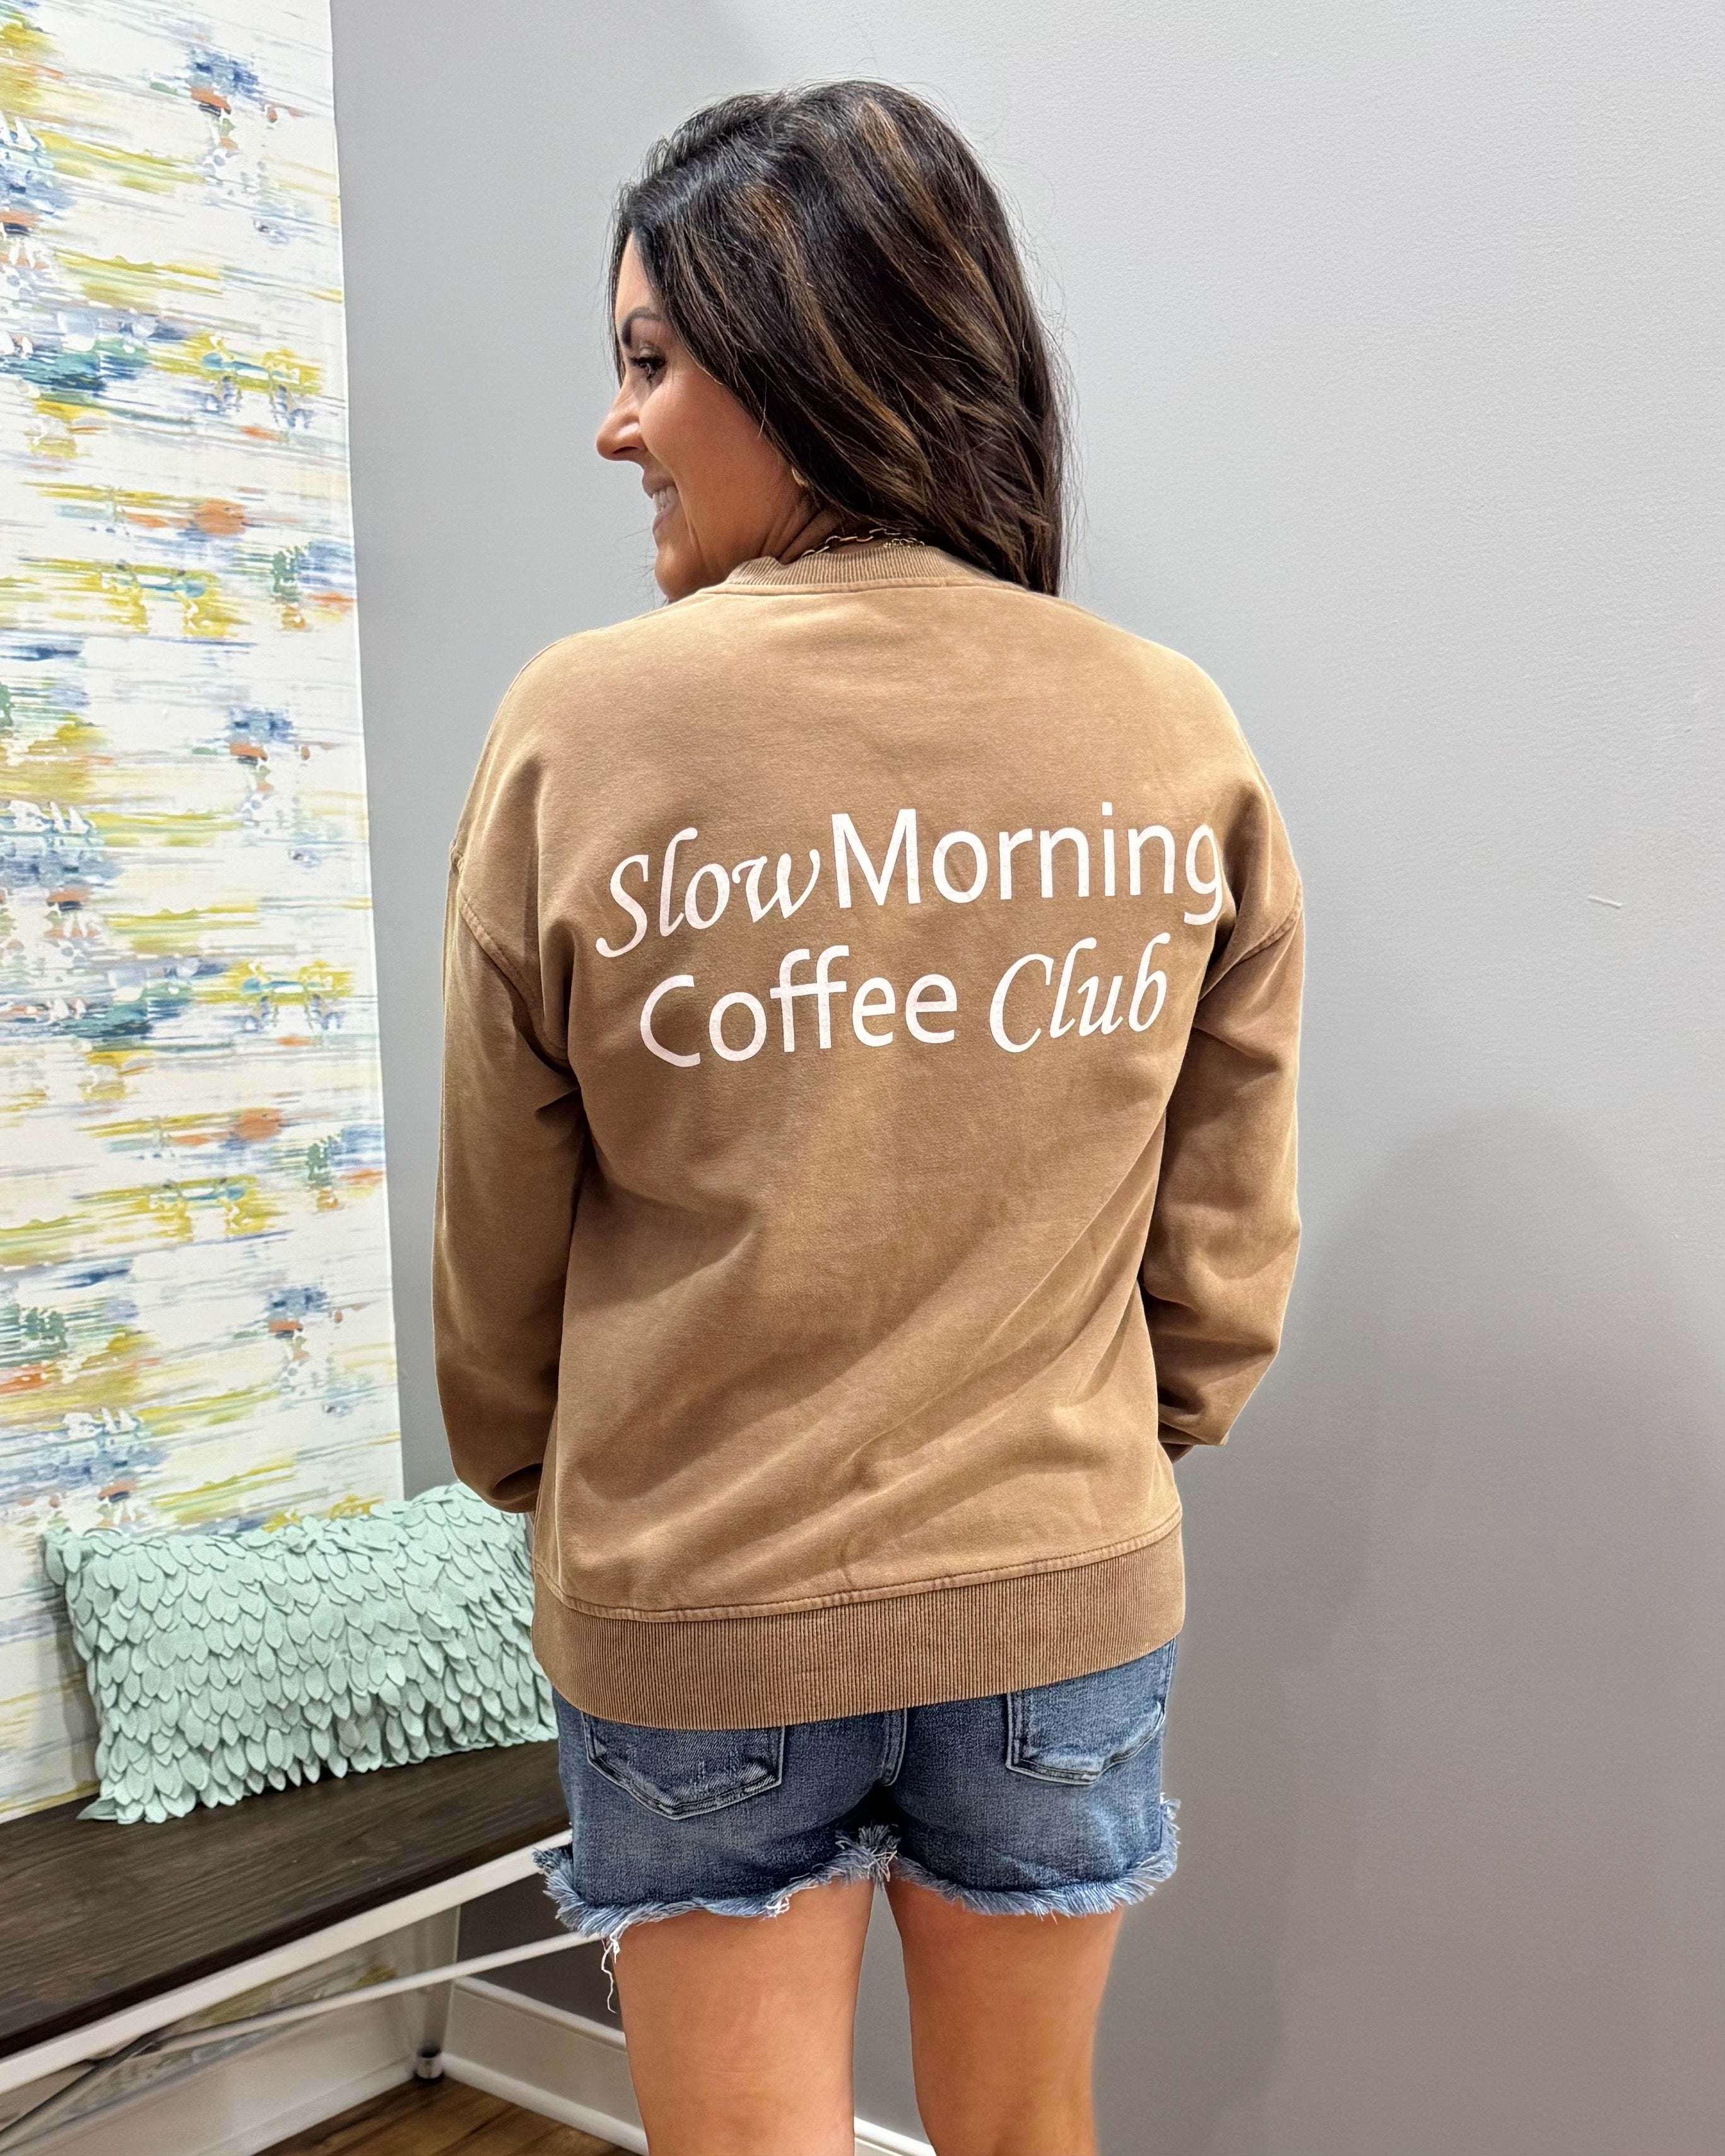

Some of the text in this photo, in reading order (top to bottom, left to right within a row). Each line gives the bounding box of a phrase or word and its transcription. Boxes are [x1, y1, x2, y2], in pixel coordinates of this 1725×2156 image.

[595, 801, 1223, 958] Slow Morning
[639, 932, 1172, 1067] Coffee Club
